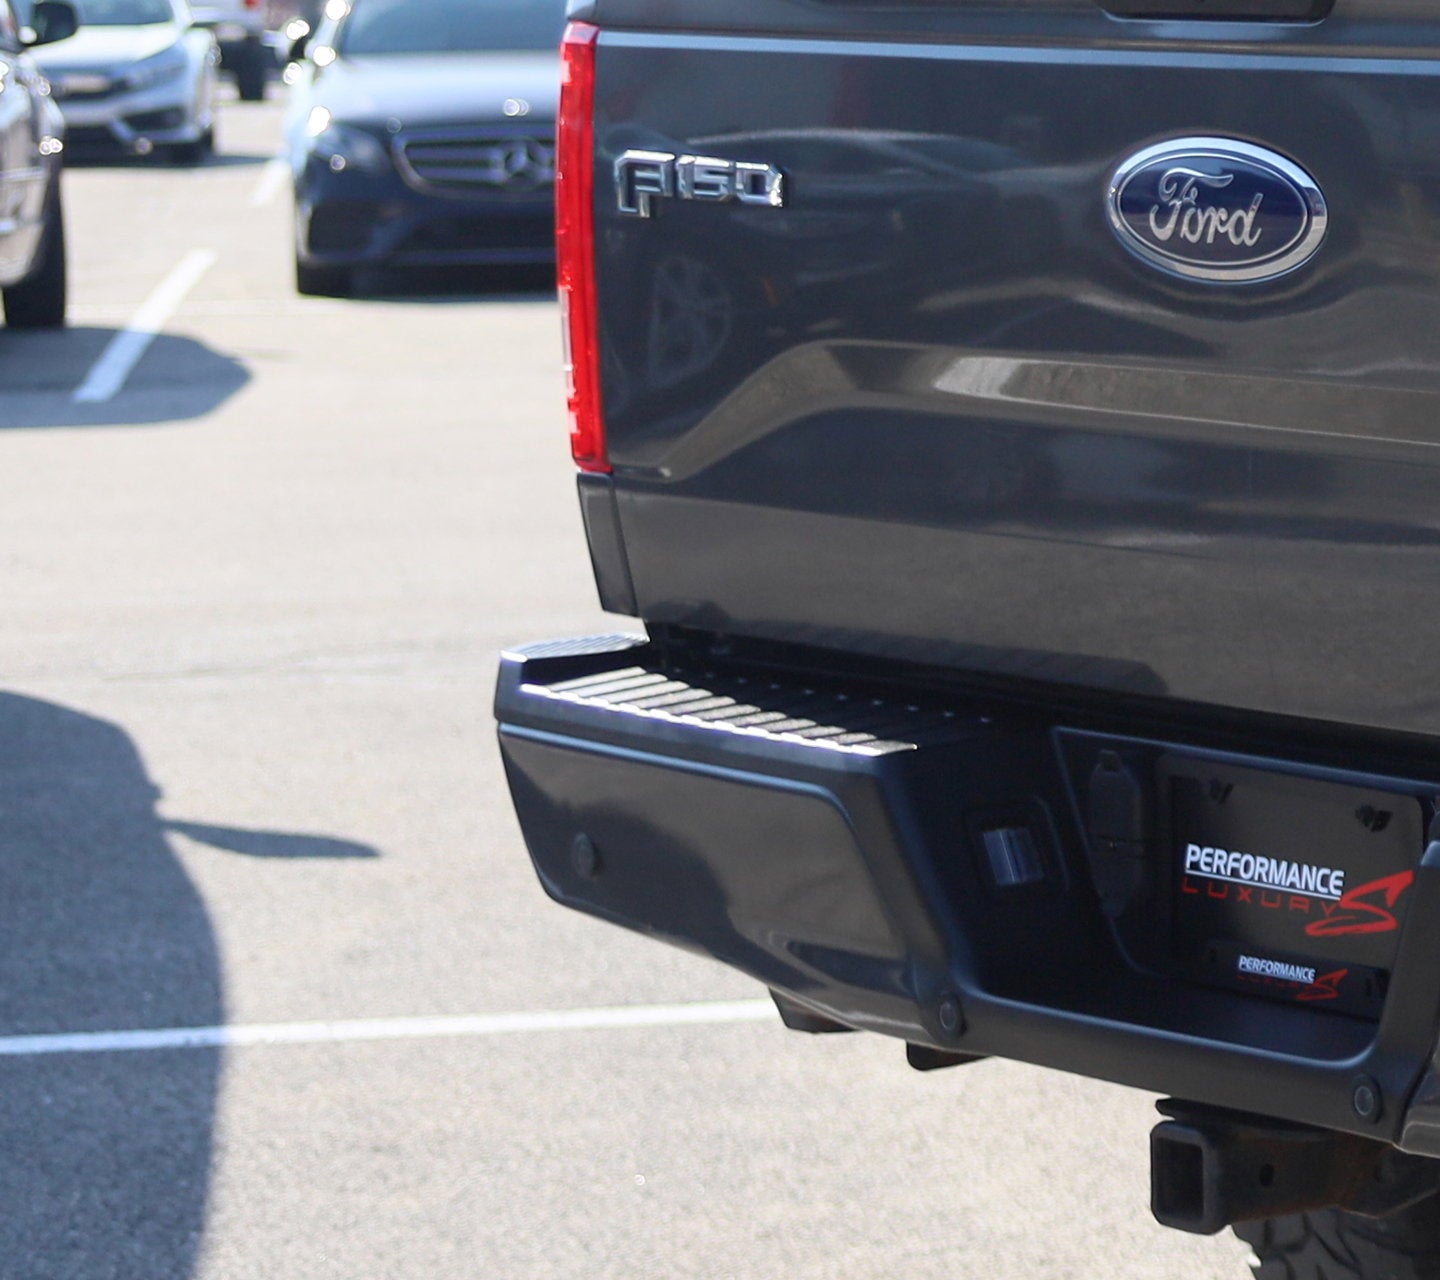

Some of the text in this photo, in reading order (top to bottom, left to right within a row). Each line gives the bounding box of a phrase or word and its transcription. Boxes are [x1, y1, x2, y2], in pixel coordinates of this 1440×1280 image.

[613, 149, 785, 219] F150
[1149, 167, 1263, 247] Ford
[1181, 876, 1338, 916] LUXURY
[1185, 843, 1345, 896] PERFORMANCE
[1238, 954, 1316, 982] PERFORMANCE
